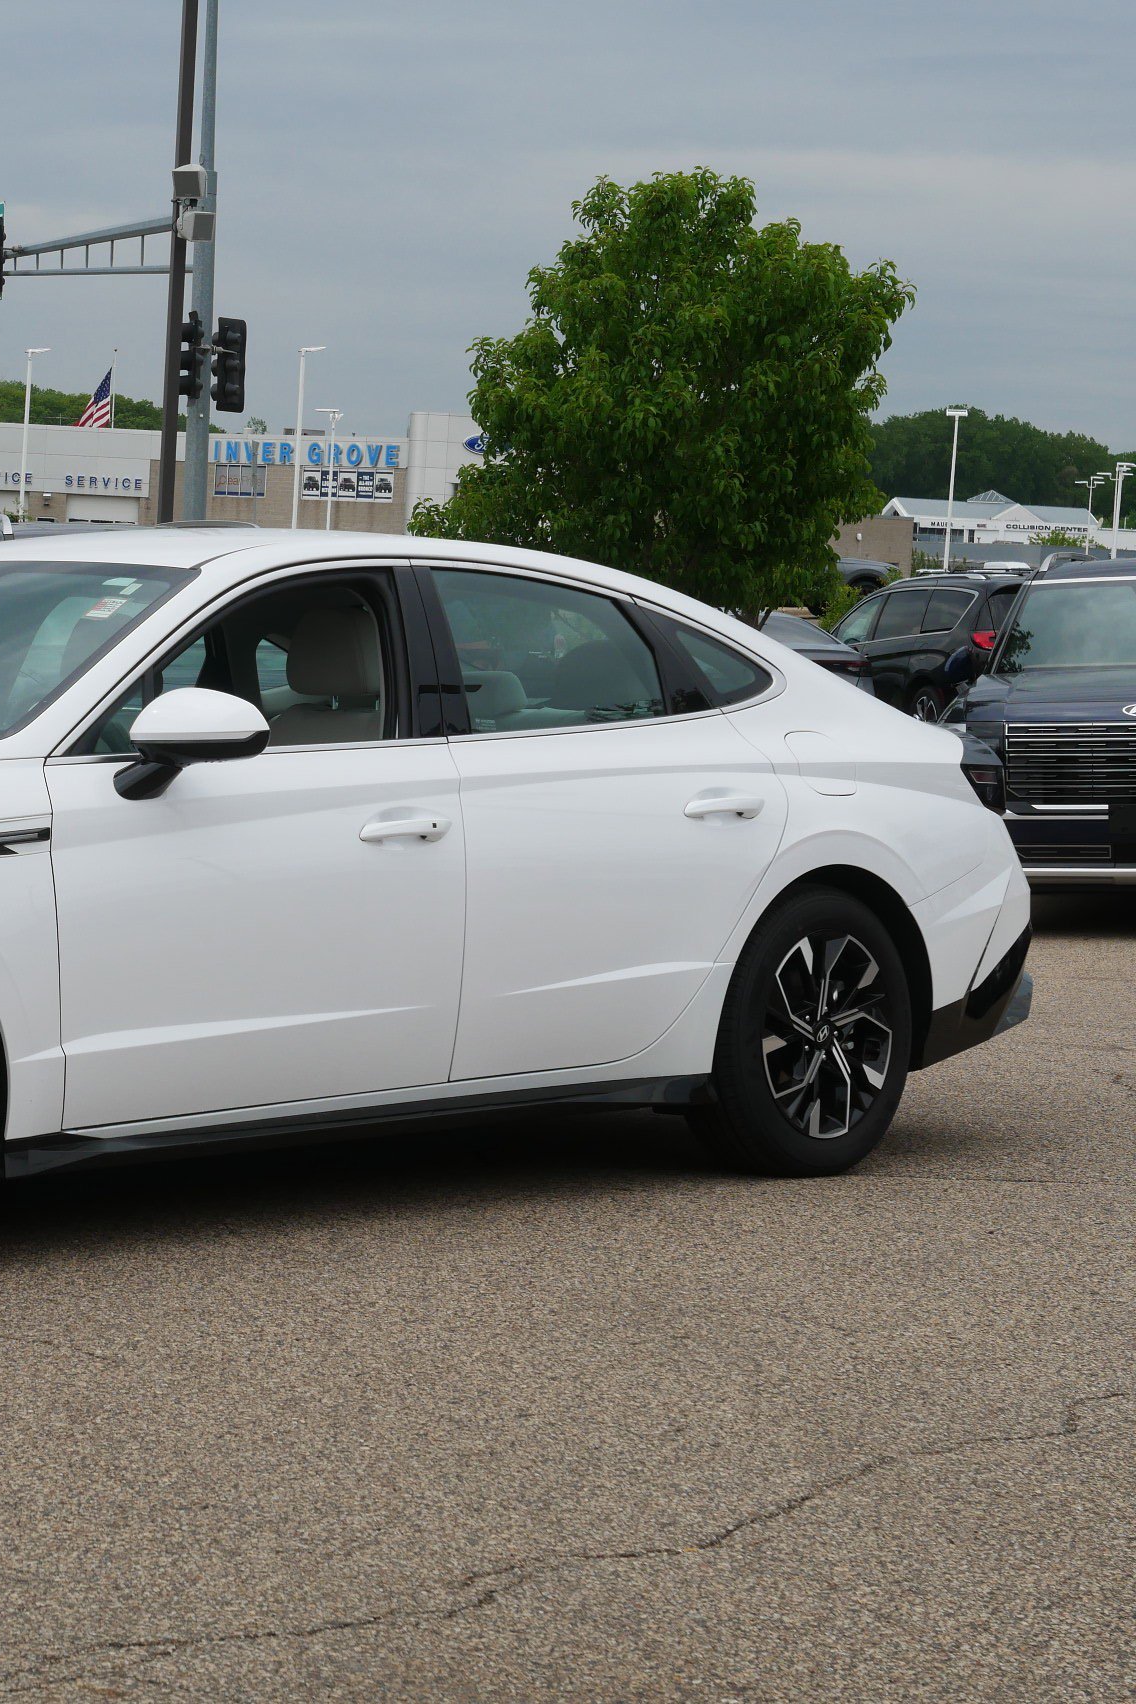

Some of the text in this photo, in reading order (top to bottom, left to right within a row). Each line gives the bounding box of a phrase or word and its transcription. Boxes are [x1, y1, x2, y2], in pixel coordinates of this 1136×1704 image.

[214, 440, 400, 467] INVER GROVE
[65, 475, 143, 490] SERVICE
[1005, 523, 1051, 531] COLLISION
